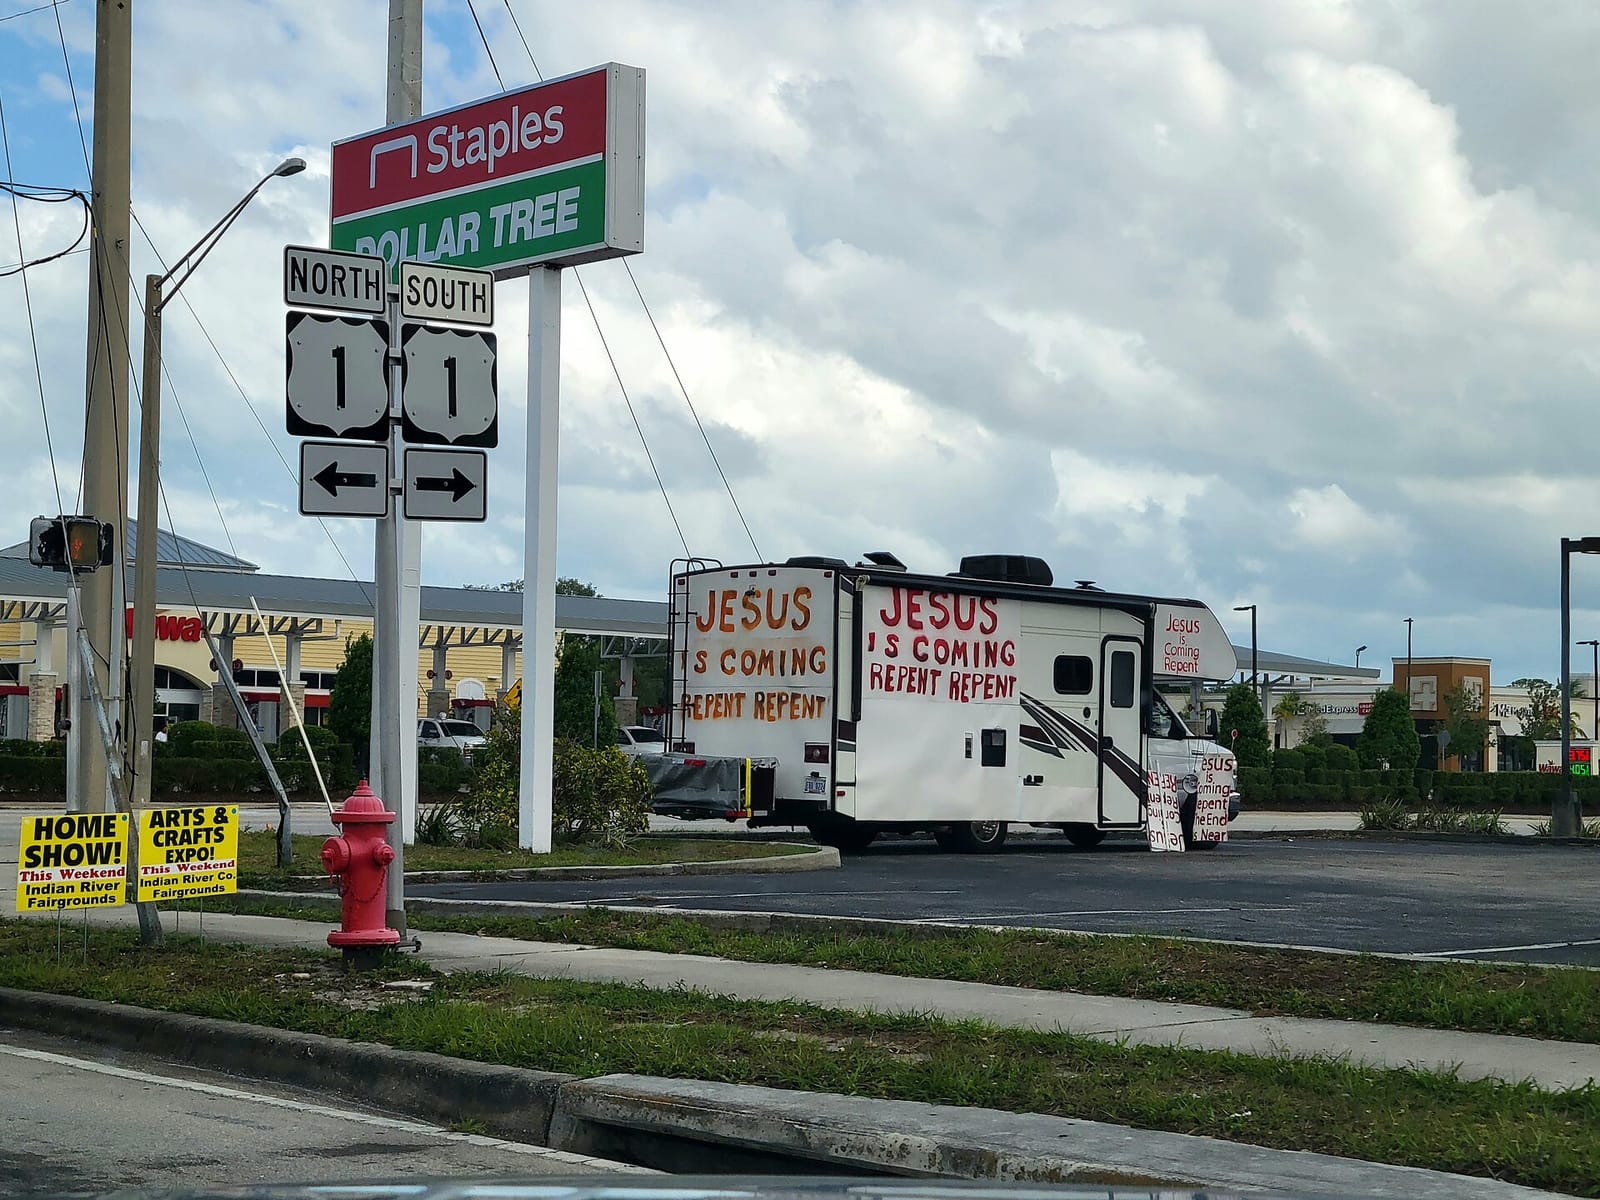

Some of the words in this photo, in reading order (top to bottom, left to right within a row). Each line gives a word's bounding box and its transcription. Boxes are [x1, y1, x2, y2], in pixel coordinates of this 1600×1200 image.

[427, 105, 564, 174] Staples
[489, 186, 580, 248] TREE
[290, 256, 380, 301] NORTH
[406, 274, 486, 314] SOUTH
[332, 345, 346, 409] 1
[443, 355, 457, 418] 1
[695, 586, 812, 633] JESUS
[880, 586, 998, 635] JESUS
[1165, 612, 1200, 633] Jesus
[1179, 632, 1186, 645] is
[720, 645, 826, 676] COMING
[868, 632, 900, 658] IS
[913, 635, 1016, 668] COMING
[1164, 642, 1200, 660] Coming
[1164, 657, 1199, 674] Repent
[870, 662, 942, 696] REPENT
[949, 671, 1017, 703] REPENT
[680, 691, 746, 720] REPENT
[753, 691, 826, 722] REPENT
[1201, 757, 1233, 772] esus
[1205, 771, 1214, 783] is
[1198, 782, 1231, 797] oming
[1197, 798, 1228, 812] epent
[34, 815, 116, 841] HOME
[149, 808, 204, 829] ARTS
[213, 806, 229, 825] &
[1206, 810, 1228, 826] End
[152, 826, 225, 847] CRAFTS
[1200, 829, 1227, 841] Near
[25, 841, 122, 868] SHOW!
[165, 847, 215, 864] EXPO!
[20, 870, 52, 882] This
[60, 866, 126, 880] Weekend
[141, 864, 170, 875] This
[176, 860, 235, 872] Weekend
[26, 883, 75, 895] Indian
[80, 881, 120, 893] River
[140, 876, 179, 887] Indian
[182, 874, 214, 885] River
[217, 872, 236, 881] Co.
[28, 893, 116, 909] Fairgrounds
[152, 884, 225, 900] Fairgrounds
